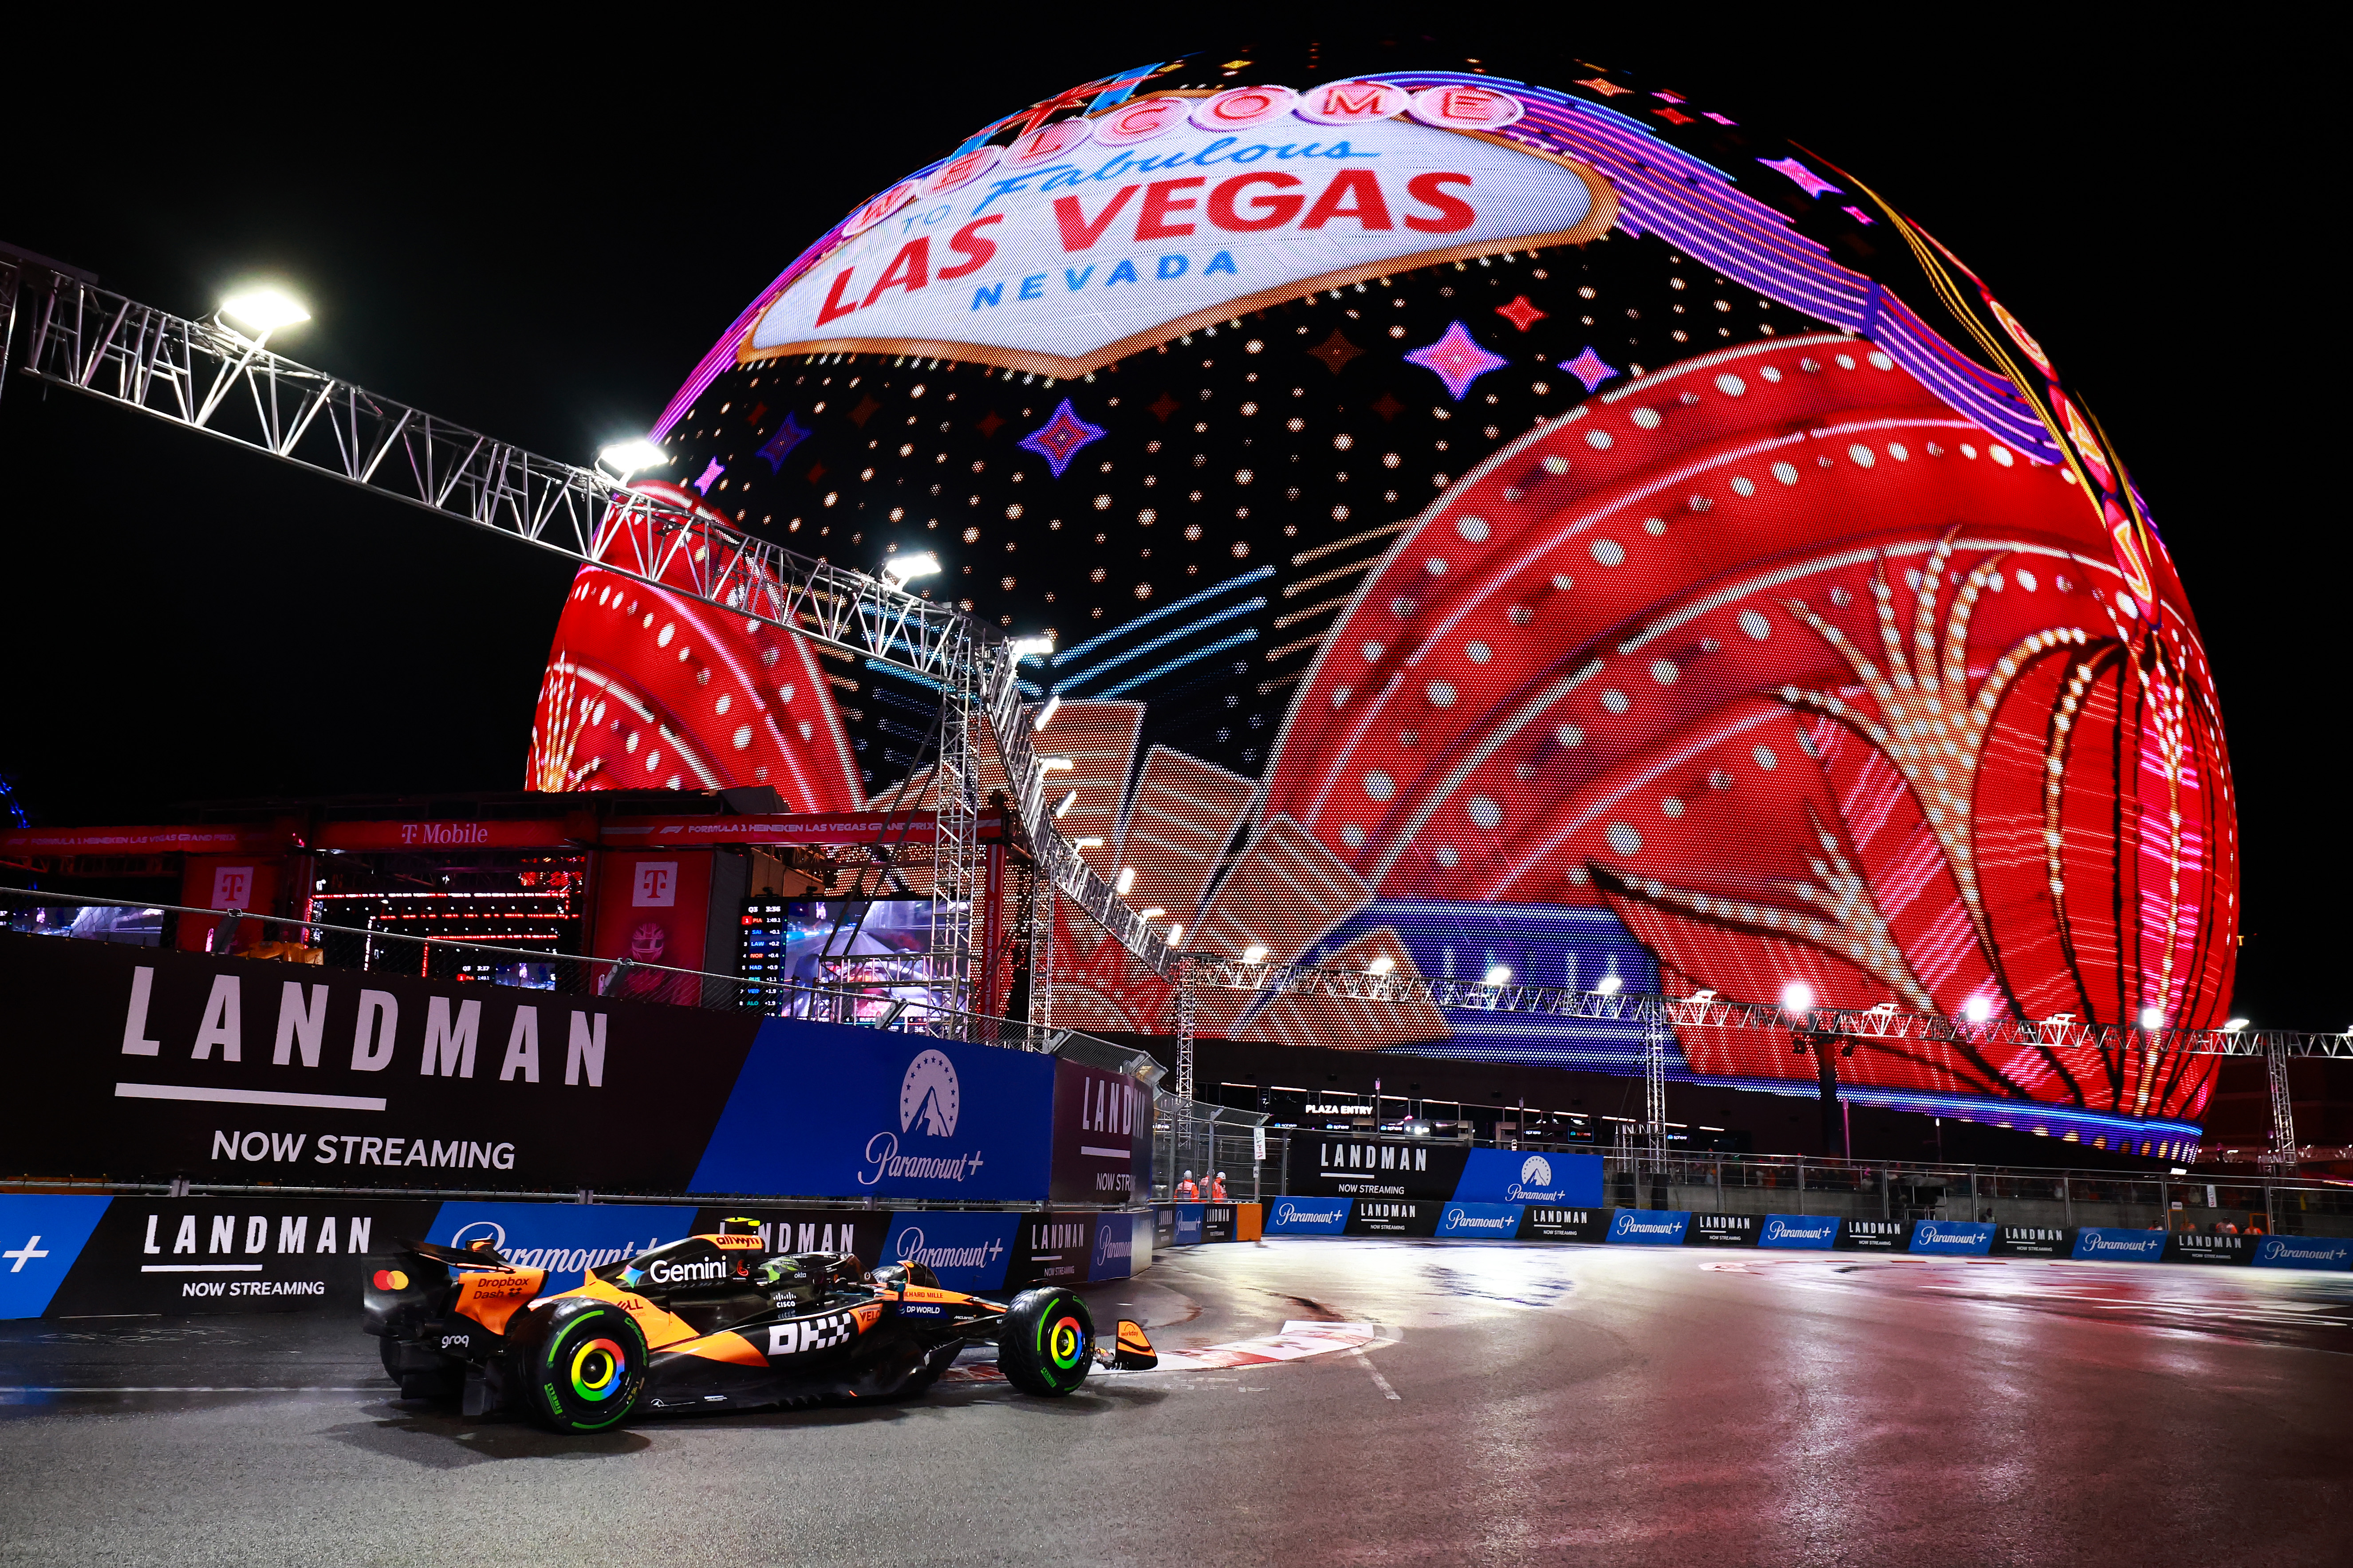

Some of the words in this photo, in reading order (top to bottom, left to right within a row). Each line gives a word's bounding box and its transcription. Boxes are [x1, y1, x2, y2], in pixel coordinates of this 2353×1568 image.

[854, 85, 1494, 227] WELCOME
[971, 136, 1381, 217] Fabulous
[903, 204, 951, 233] TO
[815, 213, 1005, 329] LAS
[1052, 169, 1477, 253] VEGAS
[970, 250, 1238, 312] NEVADA
[422, 823, 488, 843] Mobile
[689, 824, 738, 833] FORMULA
[643, 869, 667, 898] T
[121, 965, 607, 1087] LANDMAN
[1305, 1104, 1339, 1114] PLAZA
[1340, 1105, 1373, 1115] ENTRY
[210, 1130, 307, 1164] NOW
[313, 1134, 516, 1170] STREAMING
[858, 1131, 984, 1185] Paramount+
[1320, 1143, 1427, 1171] LANDMAN
[1096, 1173, 1115, 1191] NOW
[1339, 1184, 1357, 1193] NOW
[1360, 1184, 1404, 1195] STREAMING
[1505, 1183, 1565, 1202] Paramount+
[1206, 1209, 1230, 1222] LANDMAN
[1276, 1203, 1343, 1226] Paramount+
[1361, 1203, 1415, 1218] LANDMAN
[1446, 1208, 1514, 1229] Paramount+
[1533, 1210, 1587, 1224] LANDMAN
[1616, 1215, 1683, 1235] Paramount+
[1700, 1216, 1750, 1229] LANDMAN
[1768, 1221, 1831, 1241] Paramount+
[1849, 1221, 1900, 1235] LANDMAN
[143, 1215, 371, 1254] LANDMAN
[716, 1236, 760, 1247] allwyn
[1032, 1223, 1084, 1249] LANDMAN
[1919, 1226, 1986, 1245] Paramount+
[2006, 1228, 2062, 1241] LANDMAN
[2083, 1233, 2157, 1252] Paramount+
[2179, 1235, 2241, 1249] LANDMAN
[896, 1226, 1003, 1268] Paramount+
[2265, 1241, 2347, 1260] Paramount+
[650, 1256, 726, 1284] Gemini
[1044, 1268, 1055, 1277] NOW
[182, 1282, 225, 1297] NOW
[229, 1281, 325, 1296] STREAMING
[478, 1277, 530, 1288] Dropbox
[473, 1289, 504, 1300] Dash
[441, 1335, 469, 1348] groq
